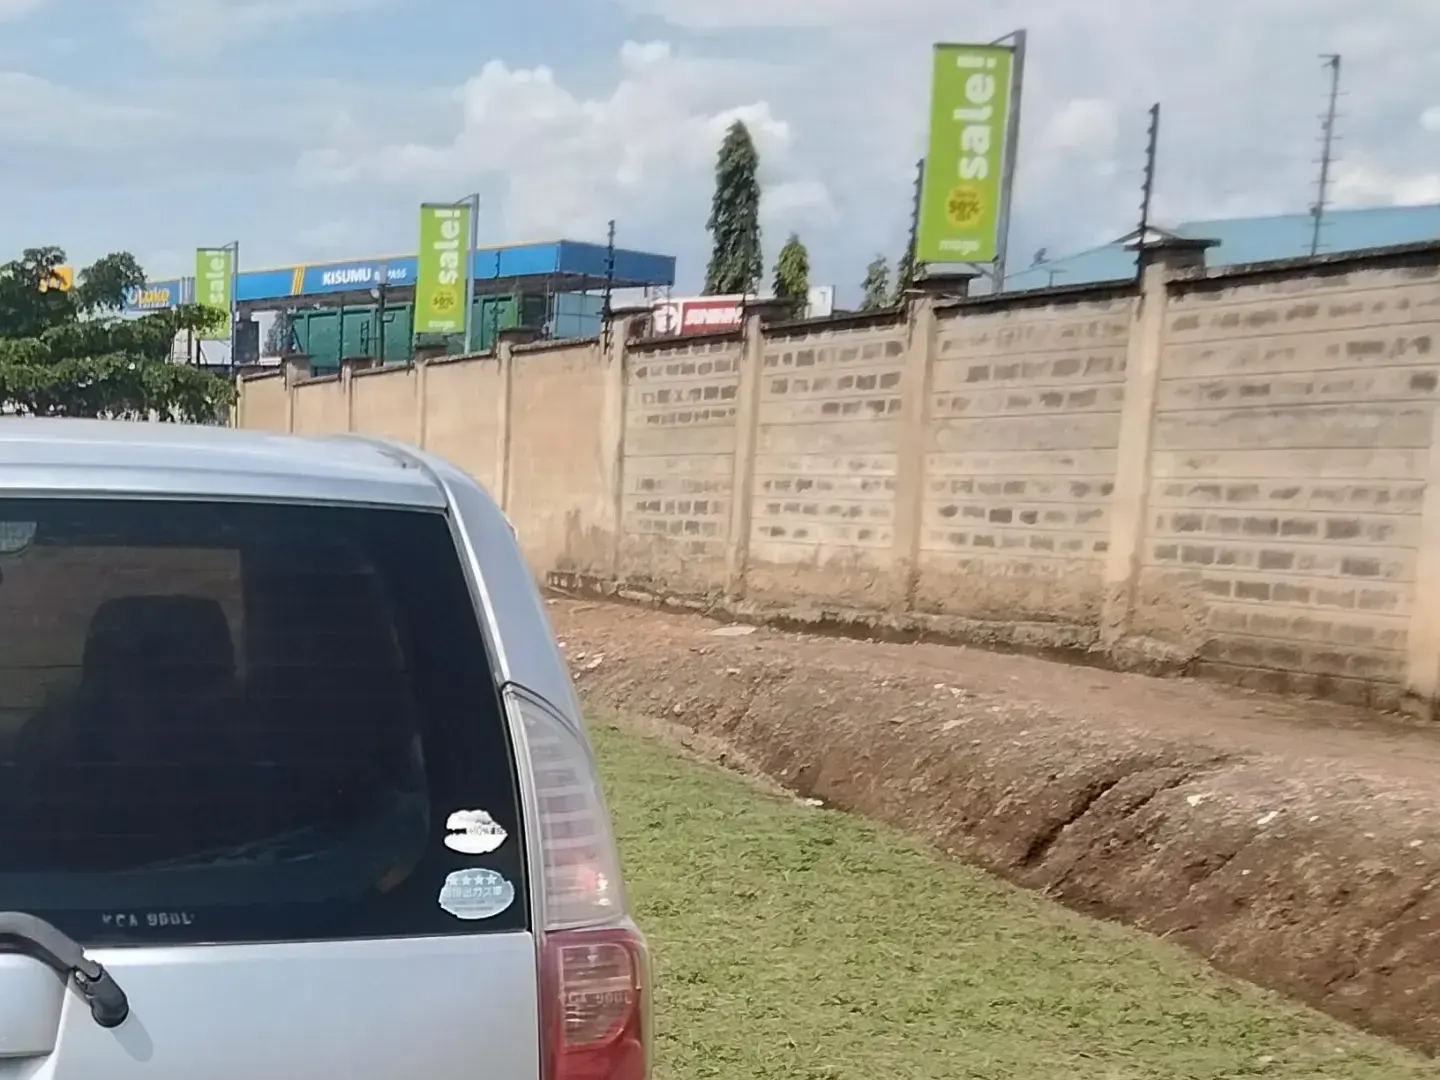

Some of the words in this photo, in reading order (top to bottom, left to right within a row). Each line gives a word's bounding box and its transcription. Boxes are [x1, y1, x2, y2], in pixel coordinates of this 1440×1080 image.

[953, 55, 997, 181] sale!
[323, 268, 372, 286] KISUMU
[433, 209, 461, 285] sale!
